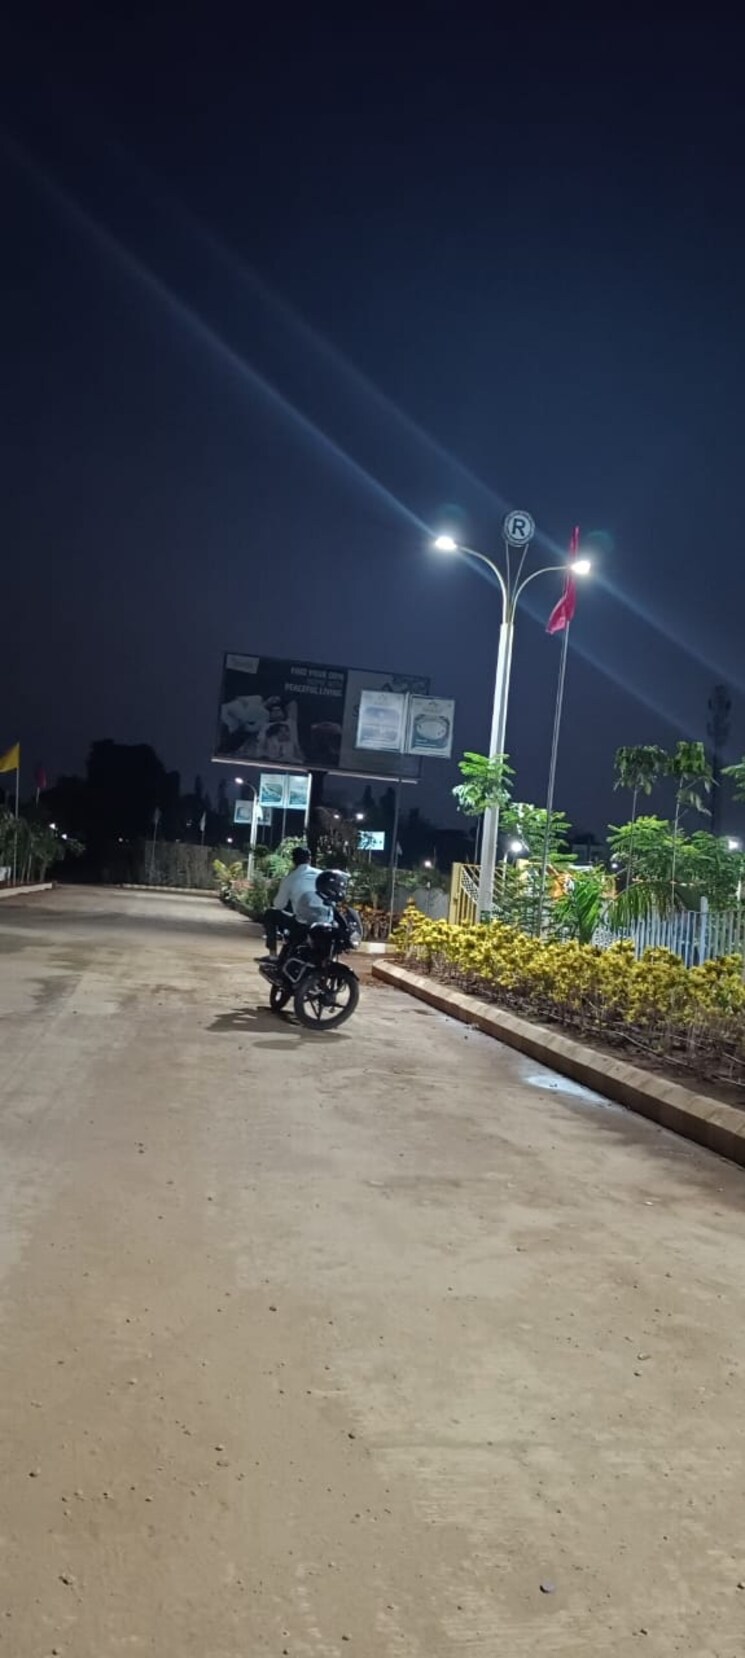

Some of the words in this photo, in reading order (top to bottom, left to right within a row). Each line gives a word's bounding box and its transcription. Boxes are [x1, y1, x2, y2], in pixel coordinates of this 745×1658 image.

[512, 518, 526, 537] R
[290, 666, 307, 677] FIND
[308, 669, 326, 679] YOUR
[284, 682, 318, 695] PEACEFUL
[319, 686, 343, 697] LIVING
